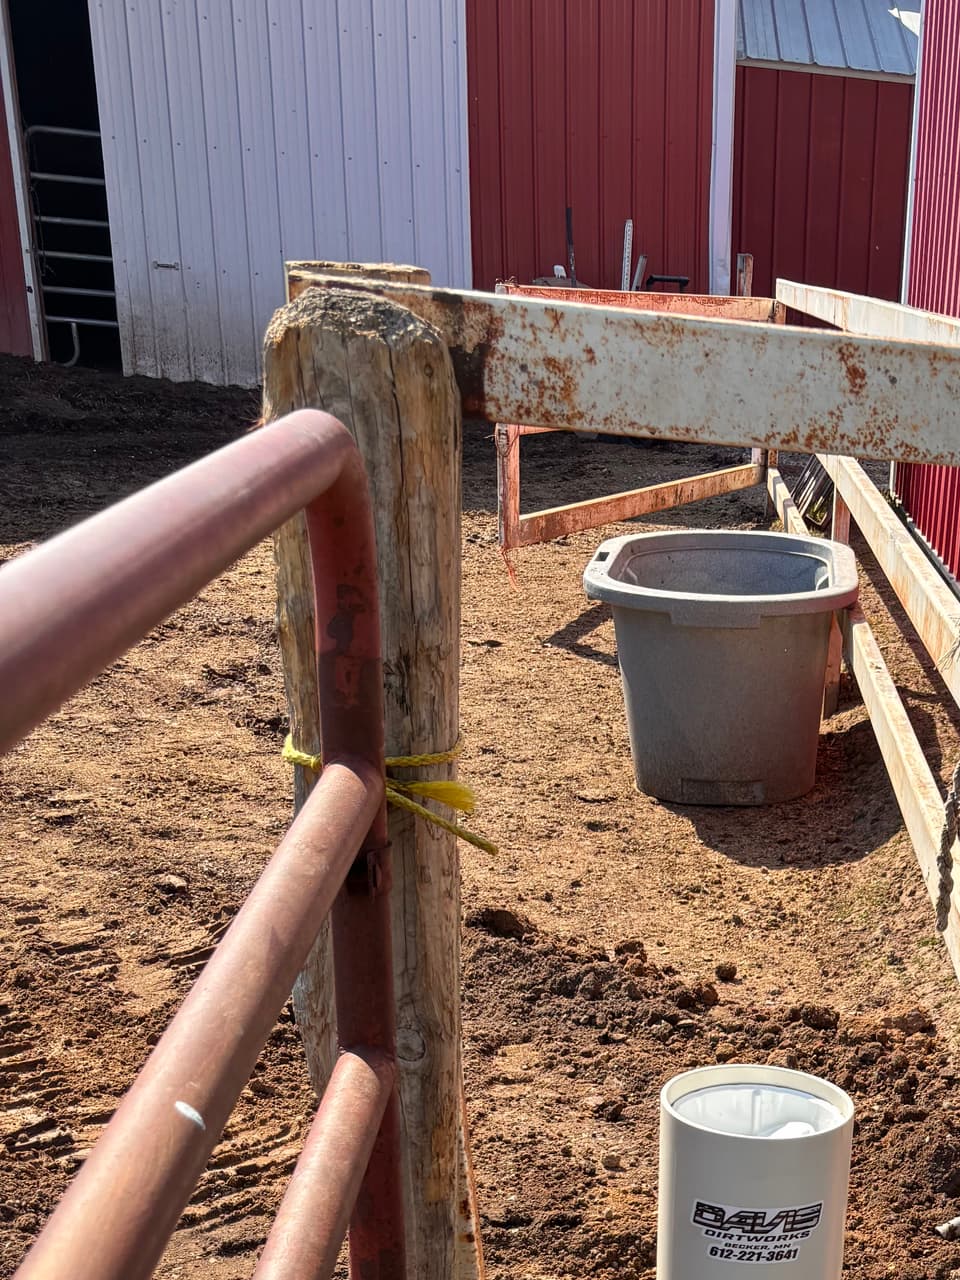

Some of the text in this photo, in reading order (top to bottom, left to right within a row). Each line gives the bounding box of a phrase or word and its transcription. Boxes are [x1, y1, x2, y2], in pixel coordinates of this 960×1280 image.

[704, 1229, 811, 1243] DIRTWORKS
[709, 1246, 799, 1262] 612-221-3641
[724, 1243, 771, 1251] BECKER,
